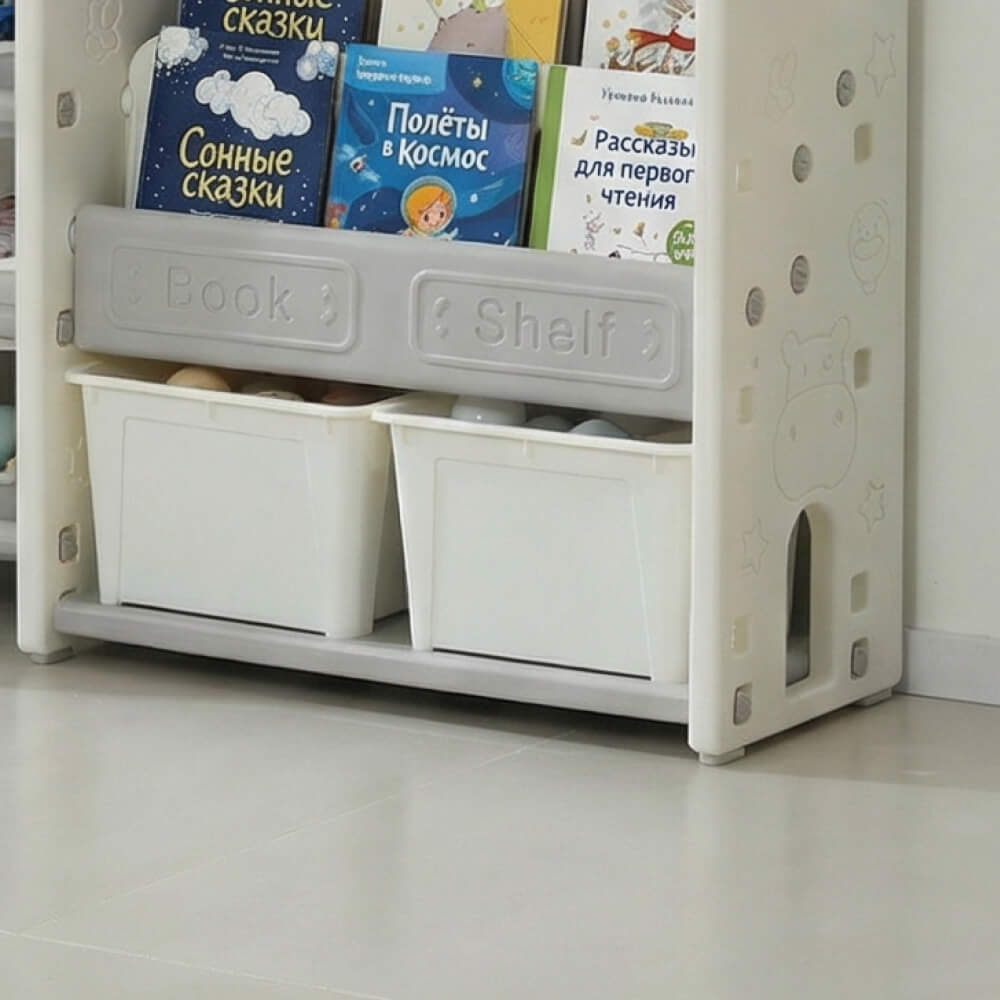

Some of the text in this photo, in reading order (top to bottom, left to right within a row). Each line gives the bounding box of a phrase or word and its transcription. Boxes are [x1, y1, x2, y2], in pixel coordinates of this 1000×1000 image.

[223, 6, 324, 40] сказки
[387, 101, 489, 141] Полёты
[179, 126, 293, 175] Сонные
[382, 137, 489, 171] в Космос
[594, 128, 695, 158] Рассказы
[574, 159, 615, 179] для
[182, 170, 284, 209] сказки
[601, 187, 677, 211] чтения
[167, 264, 617, 358] Book Shelf
